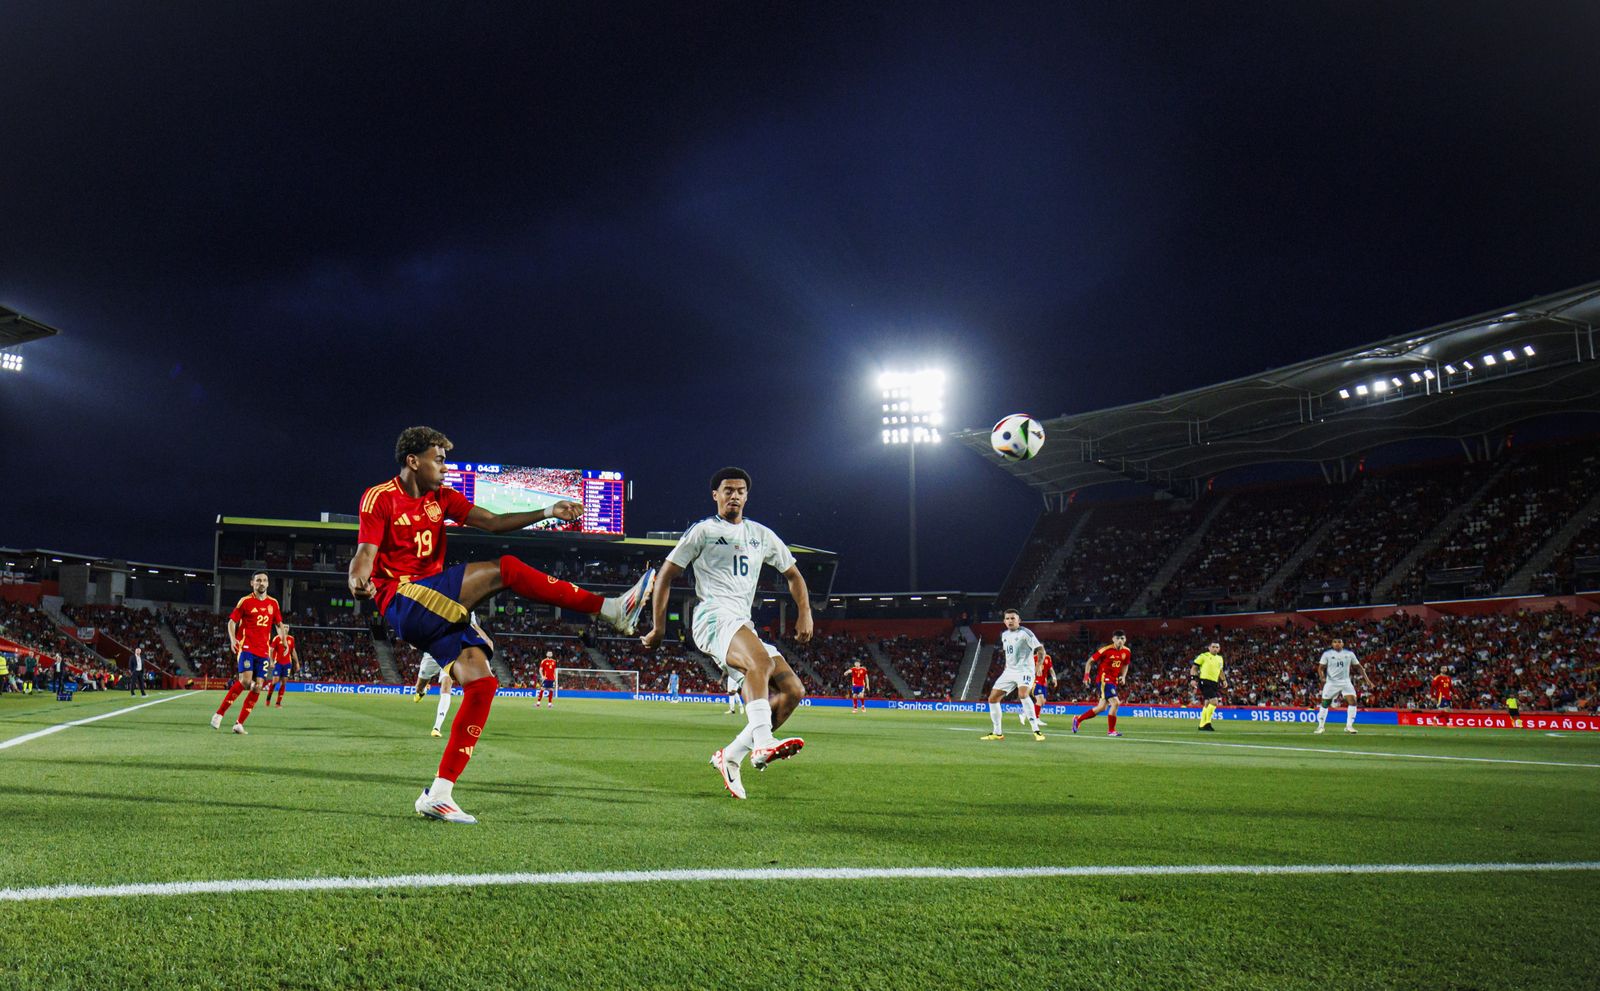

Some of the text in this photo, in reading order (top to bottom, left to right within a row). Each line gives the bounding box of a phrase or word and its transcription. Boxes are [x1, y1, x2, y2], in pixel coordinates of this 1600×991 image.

[465, 464, 472, 472] 0
[414, 529, 433, 558] 19
[733, 554, 749, 577] 16
[256, 614, 270, 627] 22
[1006, 644, 1014, 654] 18
[1111, 660, 1121, 668] 20
[1336, 660, 1344, 668] 19
[314, 683, 355, 694] Sanitas
[356, 684, 401, 695] Campus
[496, 687, 533, 698] ampus
[897, 701, 987, 713] Sanitas Campus FP
[1055, 705, 1067, 715] FP
[1133, 707, 1224, 720] sanitascampues
[1250, 710, 1271, 721] 915
[1273, 711, 1296, 723] 859
